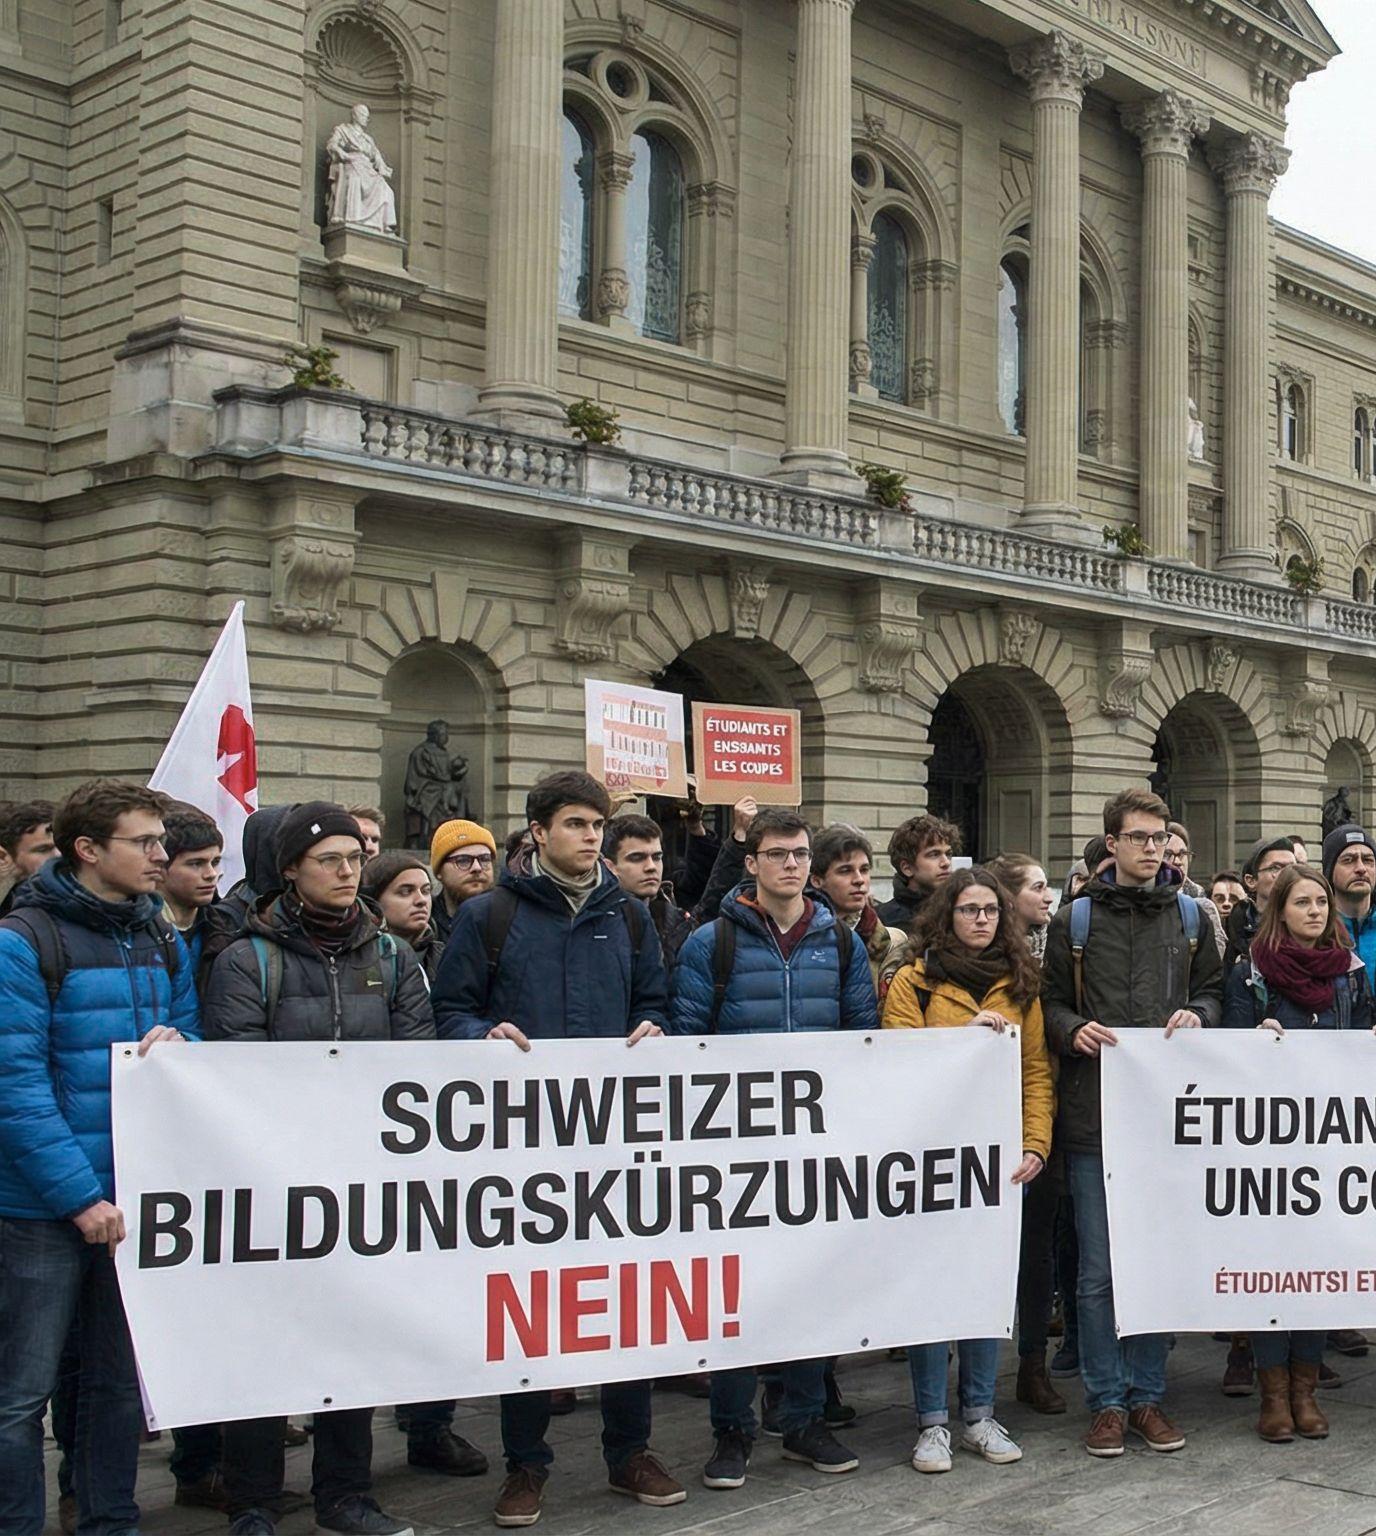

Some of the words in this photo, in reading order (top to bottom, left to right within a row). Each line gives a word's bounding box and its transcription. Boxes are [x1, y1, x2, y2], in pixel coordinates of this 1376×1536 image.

[706, 716, 771, 736] ÉTUDIANTS
[773, 724, 787, 736] ET
[714, 760, 737, 773] LES
[740, 761, 783, 776] COUPES
[381, 1069, 827, 1155] SCHWEIZER
[138, 1144, 1001, 1269] BILDUNGSKÜRZUNGEN
[1205, 1166, 1321, 1217] UNIS
[486, 1255, 741, 1361] NEIN!
